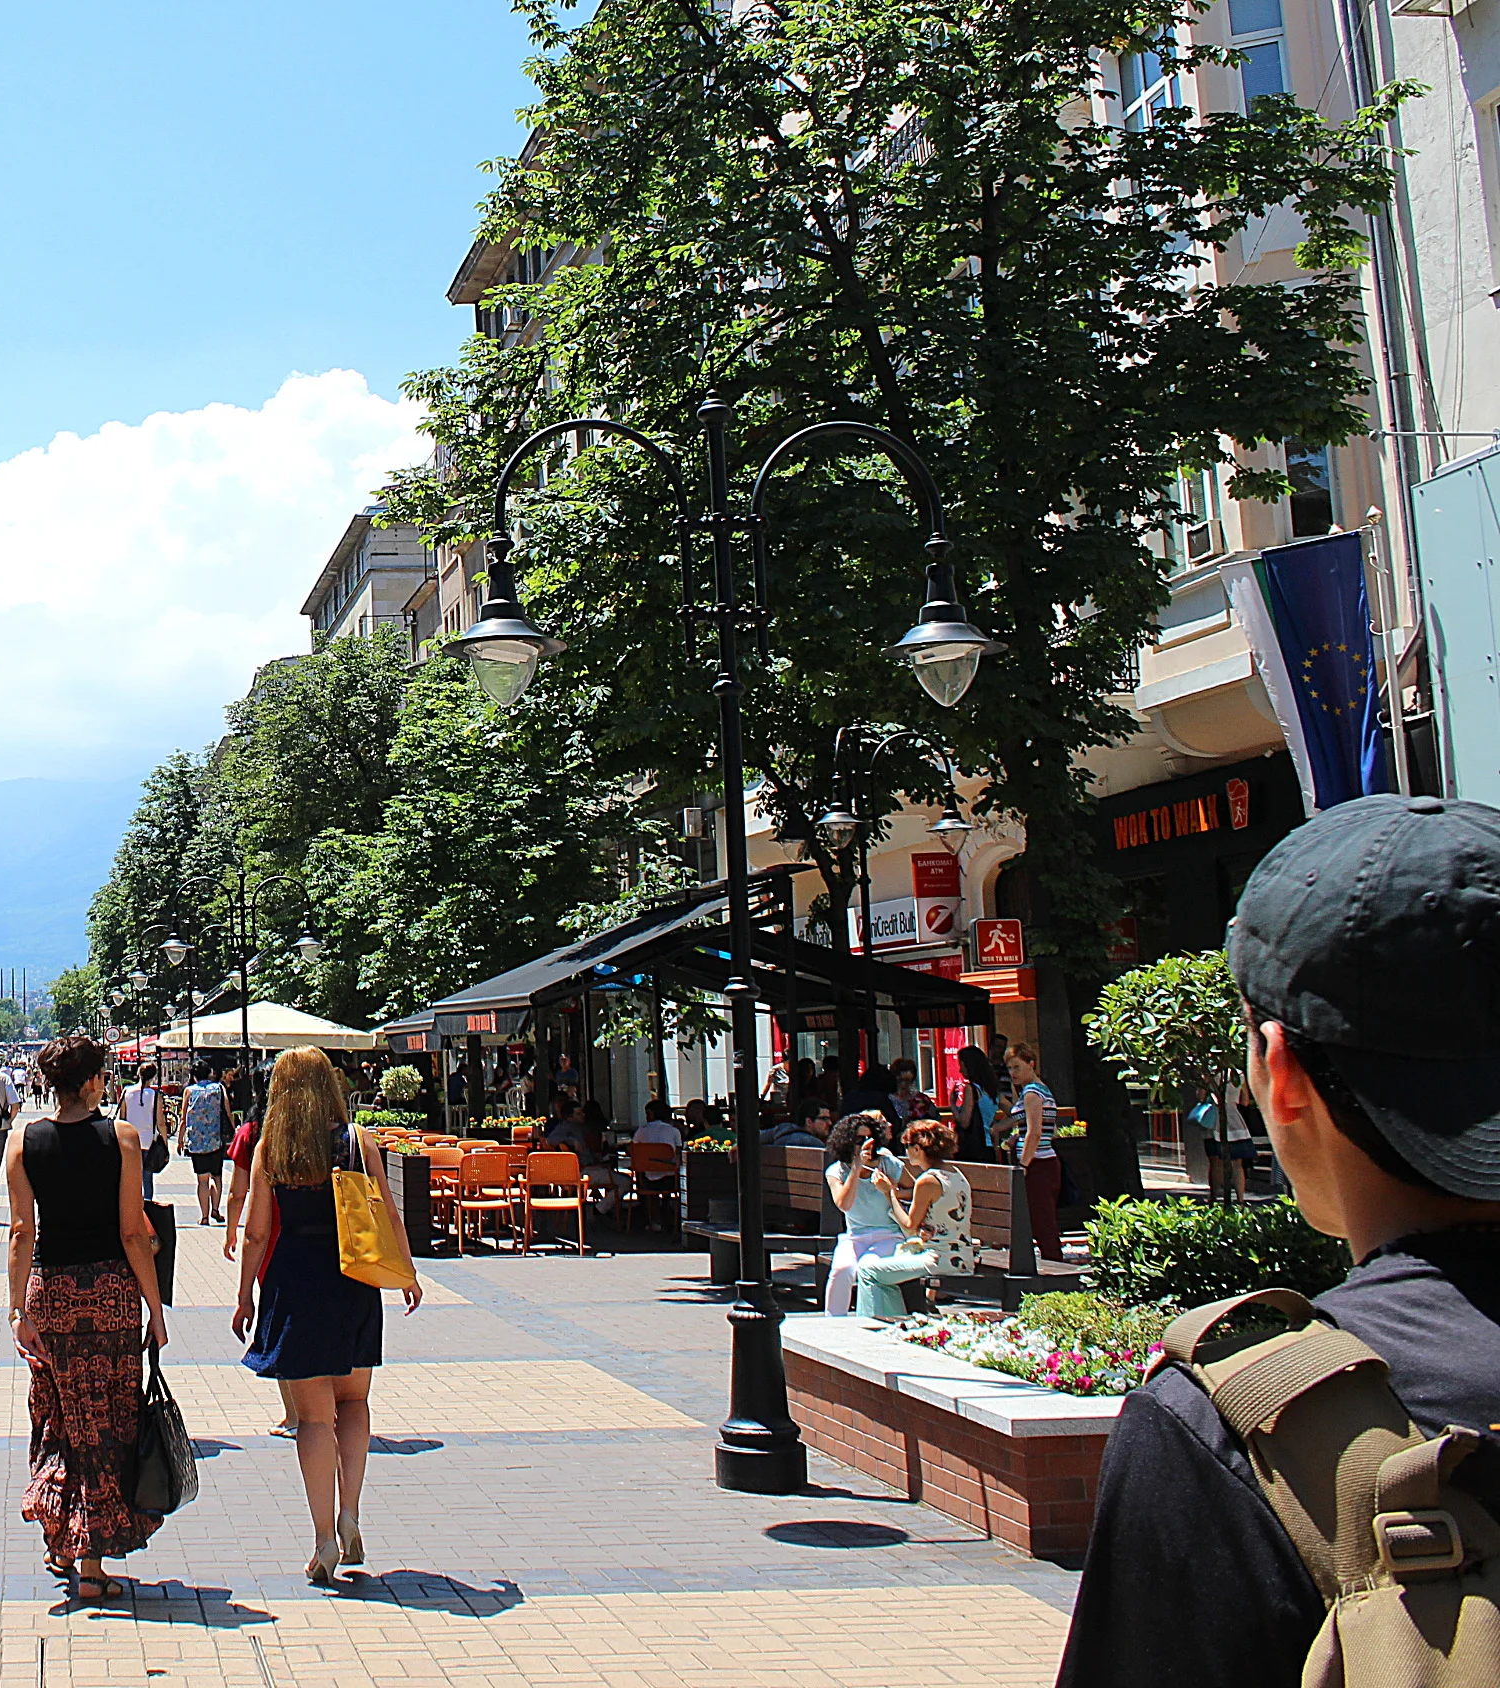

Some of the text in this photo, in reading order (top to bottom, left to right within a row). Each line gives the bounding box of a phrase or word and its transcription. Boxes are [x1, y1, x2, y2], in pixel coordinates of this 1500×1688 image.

[1114, 794, 1220, 850] WOK TO WALK
[917, 859, 953, 868] БАНКОМАТ
[870, 909, 917, 939] niCredit Bulb
